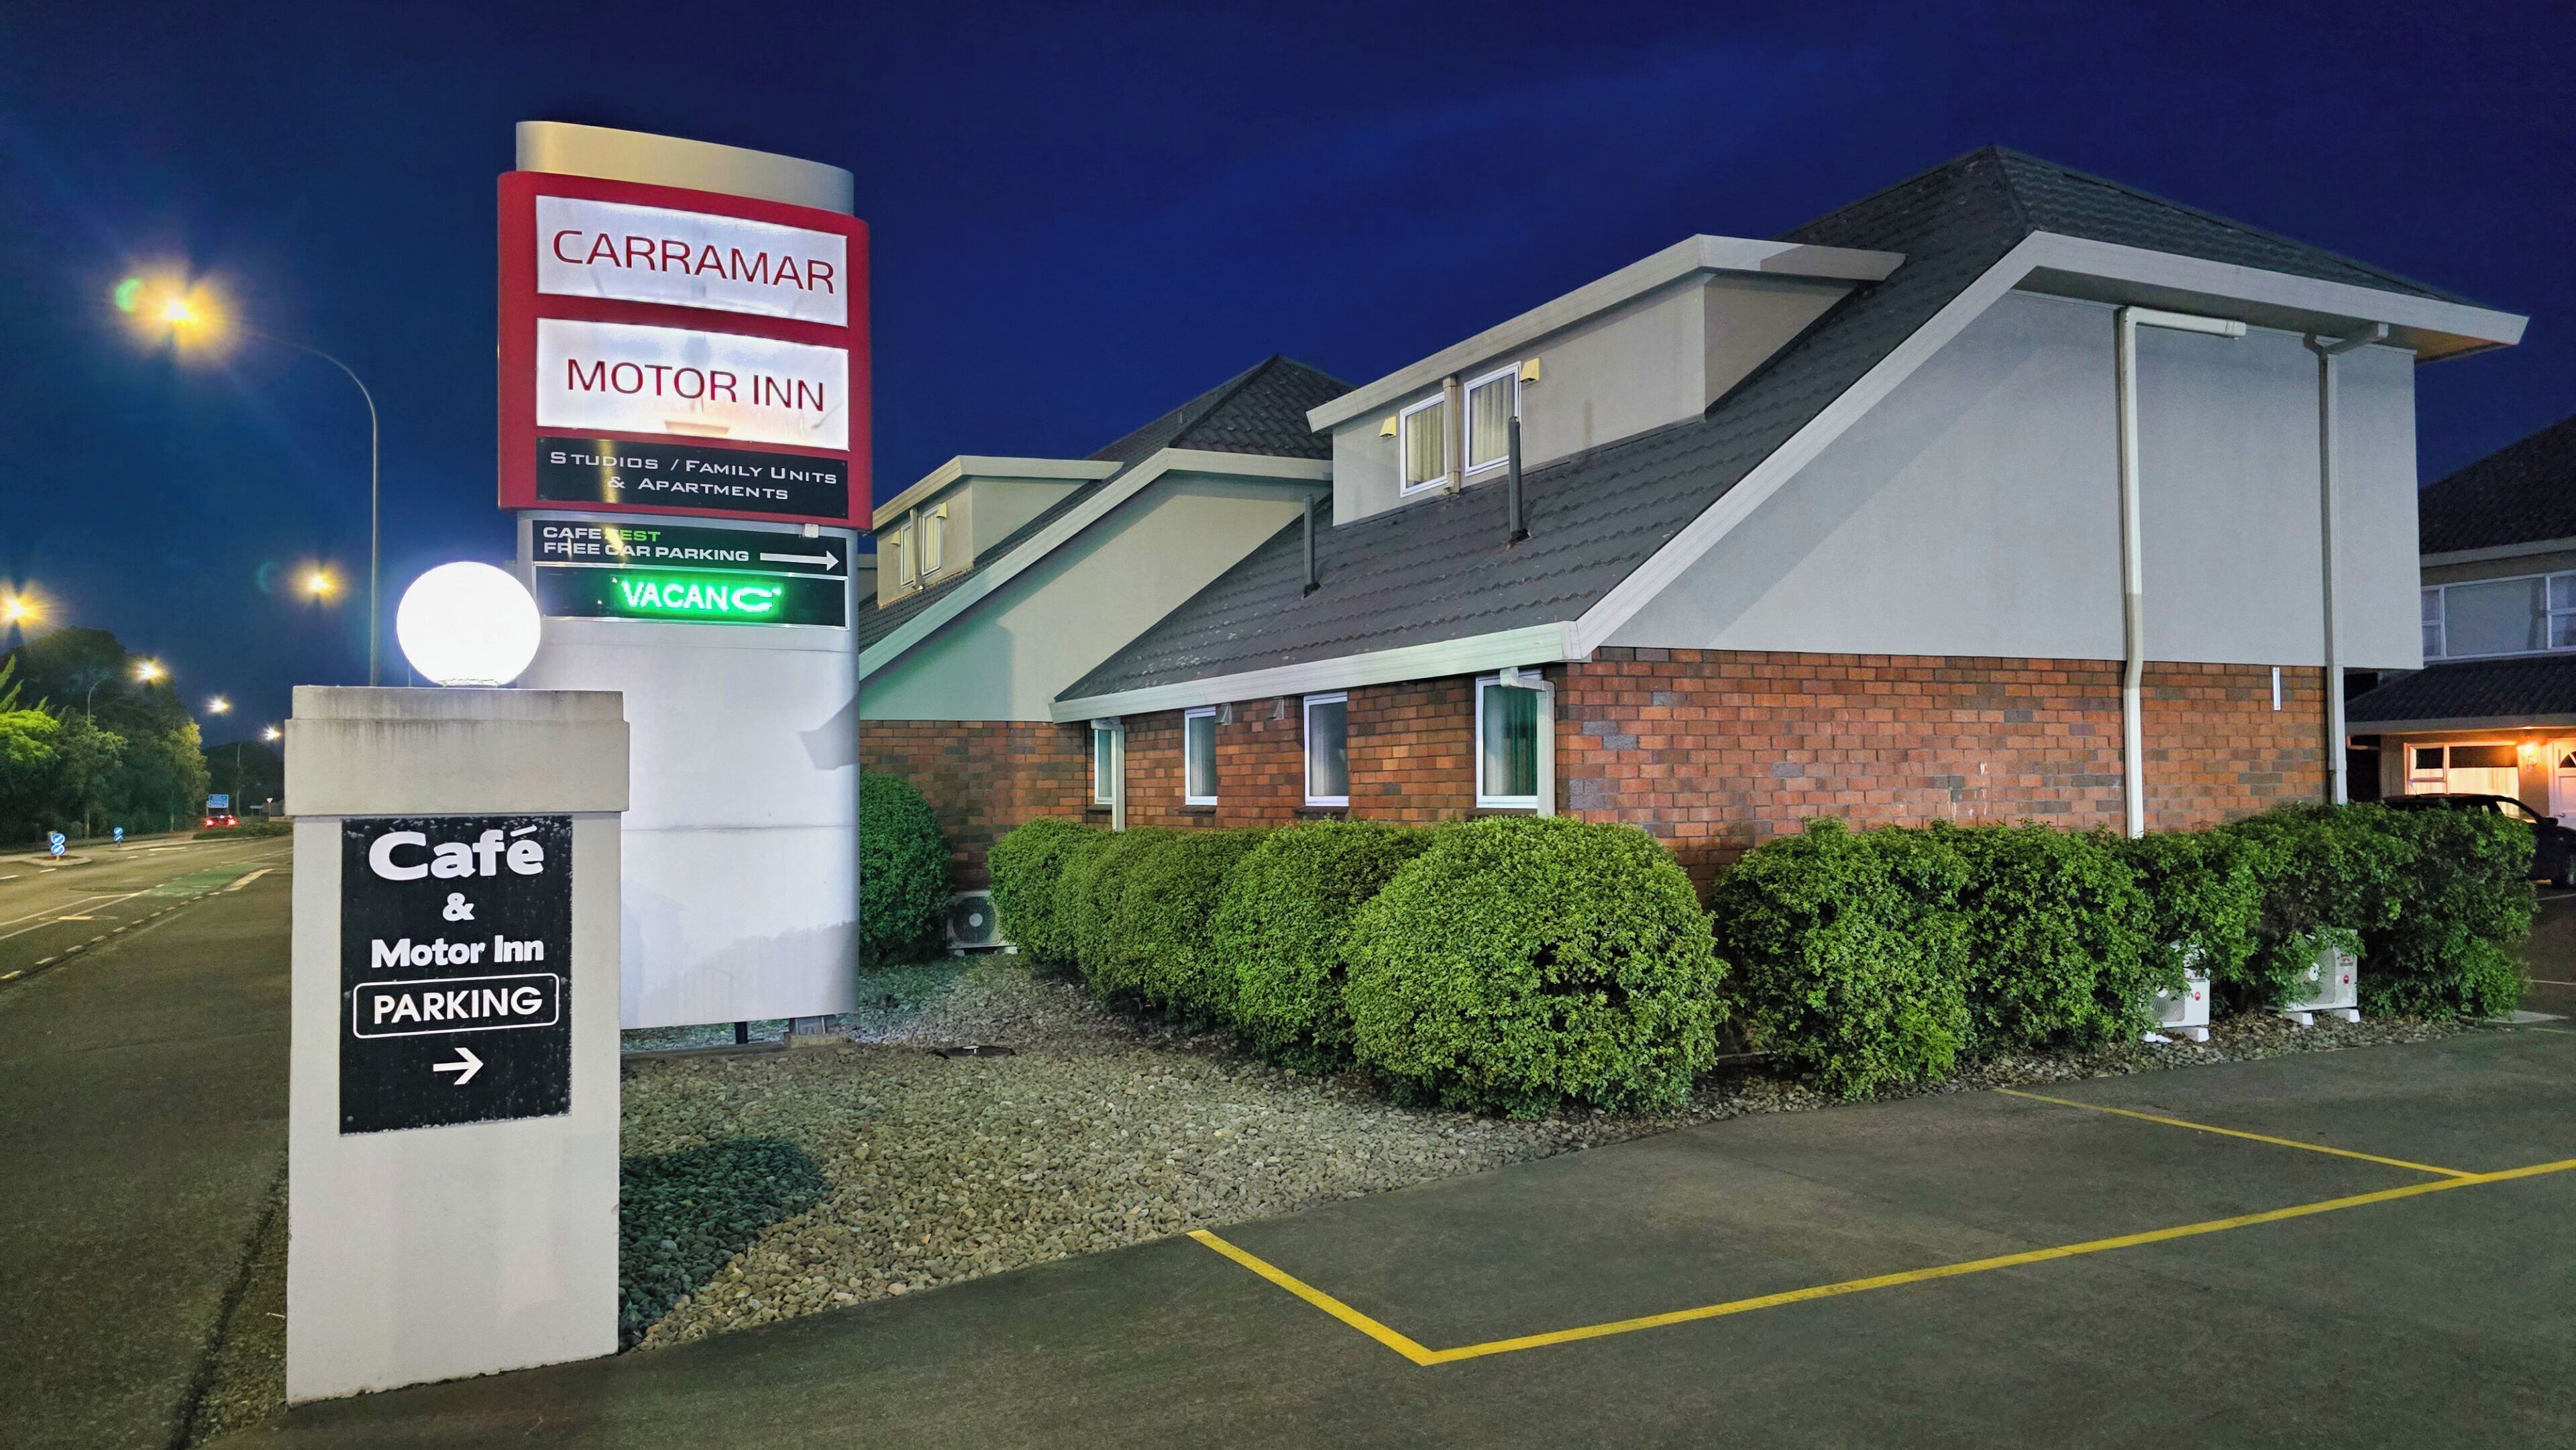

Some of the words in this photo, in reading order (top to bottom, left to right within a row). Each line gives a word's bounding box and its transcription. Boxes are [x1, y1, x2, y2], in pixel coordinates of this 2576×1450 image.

[553, 231, 835, 294] CARRAMAR
[567, 359, 737, 402] MOTOR
[753, 374, 824, 412] INN
[607, 476, 625, 489] &
[638, 478, 789, 500] APARTMENTS
[771, 467, 837, 484] UNITS
[543, 526, 602, 539] CAFE
[543, 542, 601, 555] FREE
[604, 545, 651, 557] CAR
[655, 547, 749, 562] PARKING
[369, 826, 544, 881] Café
[442, 893, 475, 921] &
[371, 938, 486, 968] Motor
[494, 935, 544, 963] Inn
[374, 987, 543, 1024] PARKING
